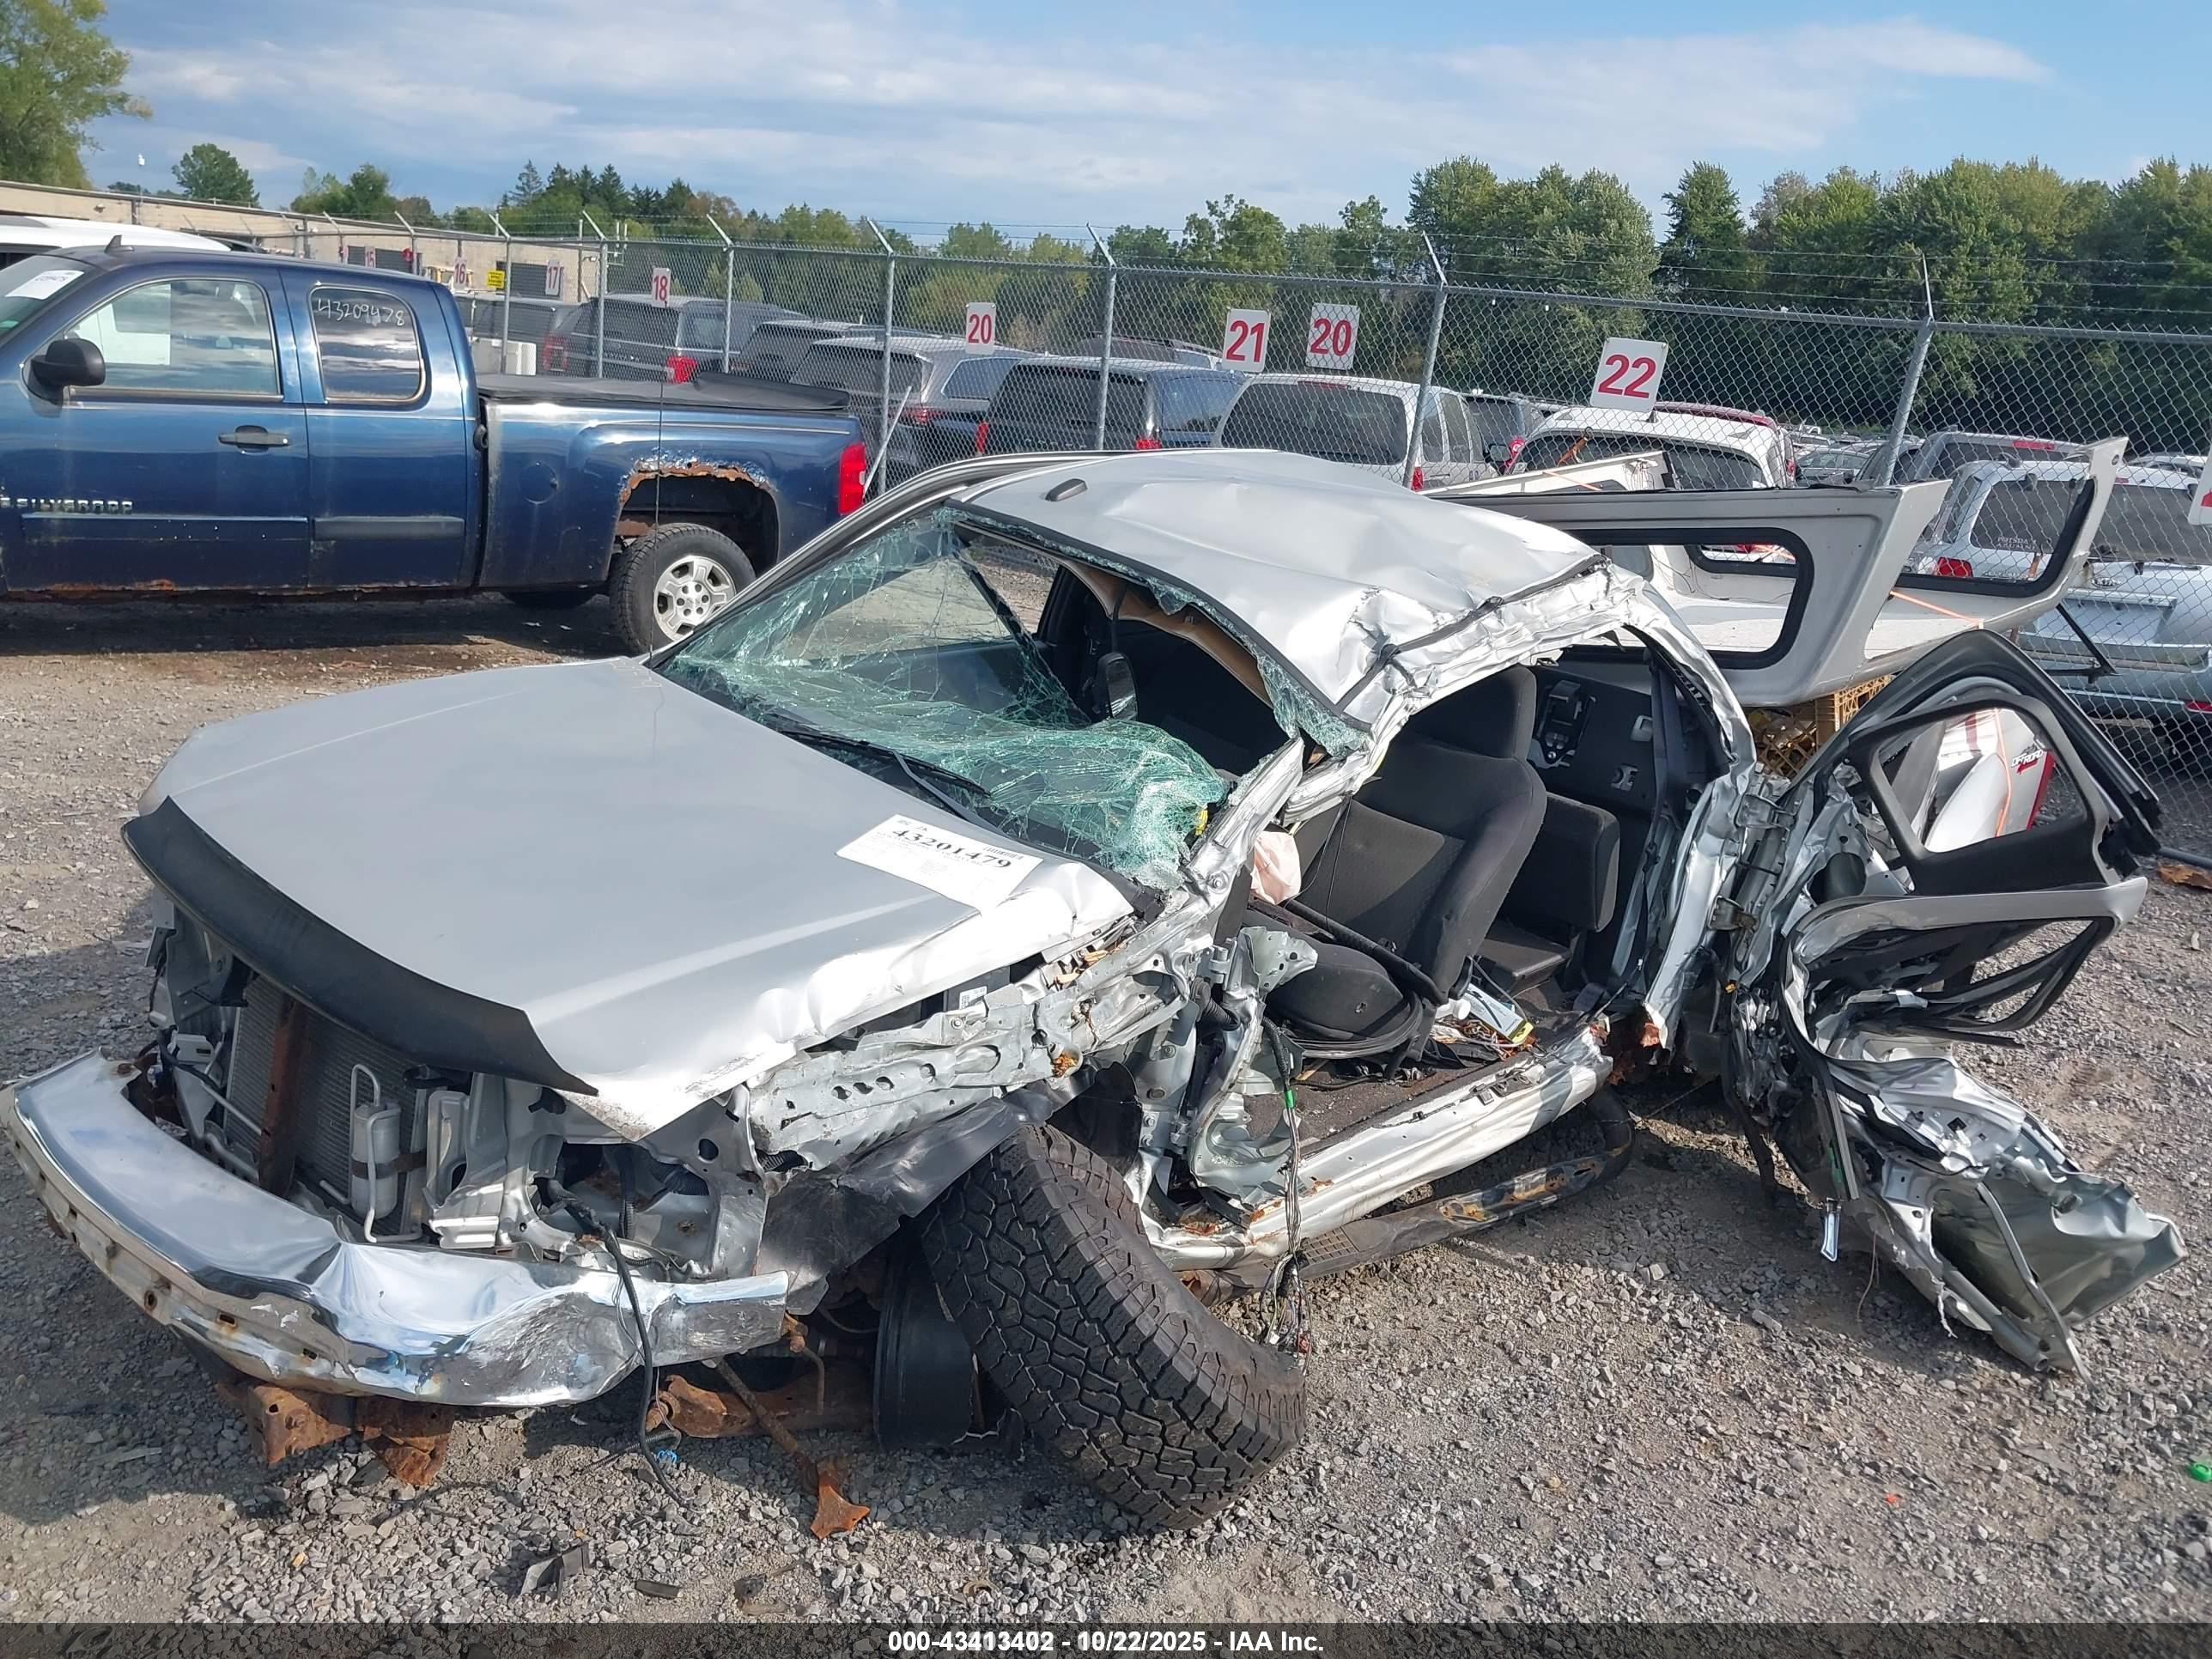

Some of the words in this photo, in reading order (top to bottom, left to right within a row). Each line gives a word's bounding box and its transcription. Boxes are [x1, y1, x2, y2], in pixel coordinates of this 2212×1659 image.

[453, 262, 465, 283] 16
[548, 267, 559, 289] 17
[653, 279, 667, 301] 18
[317, 297, 405, 326] 43209478
[967, 313, 994, 345] 20
[1226, 319, 1266, 362] 21
[1310, 317, 1352, 356] 20
[1598, 353, 1657, 399] 22
[892, 829, 1012, 868] 43201479
